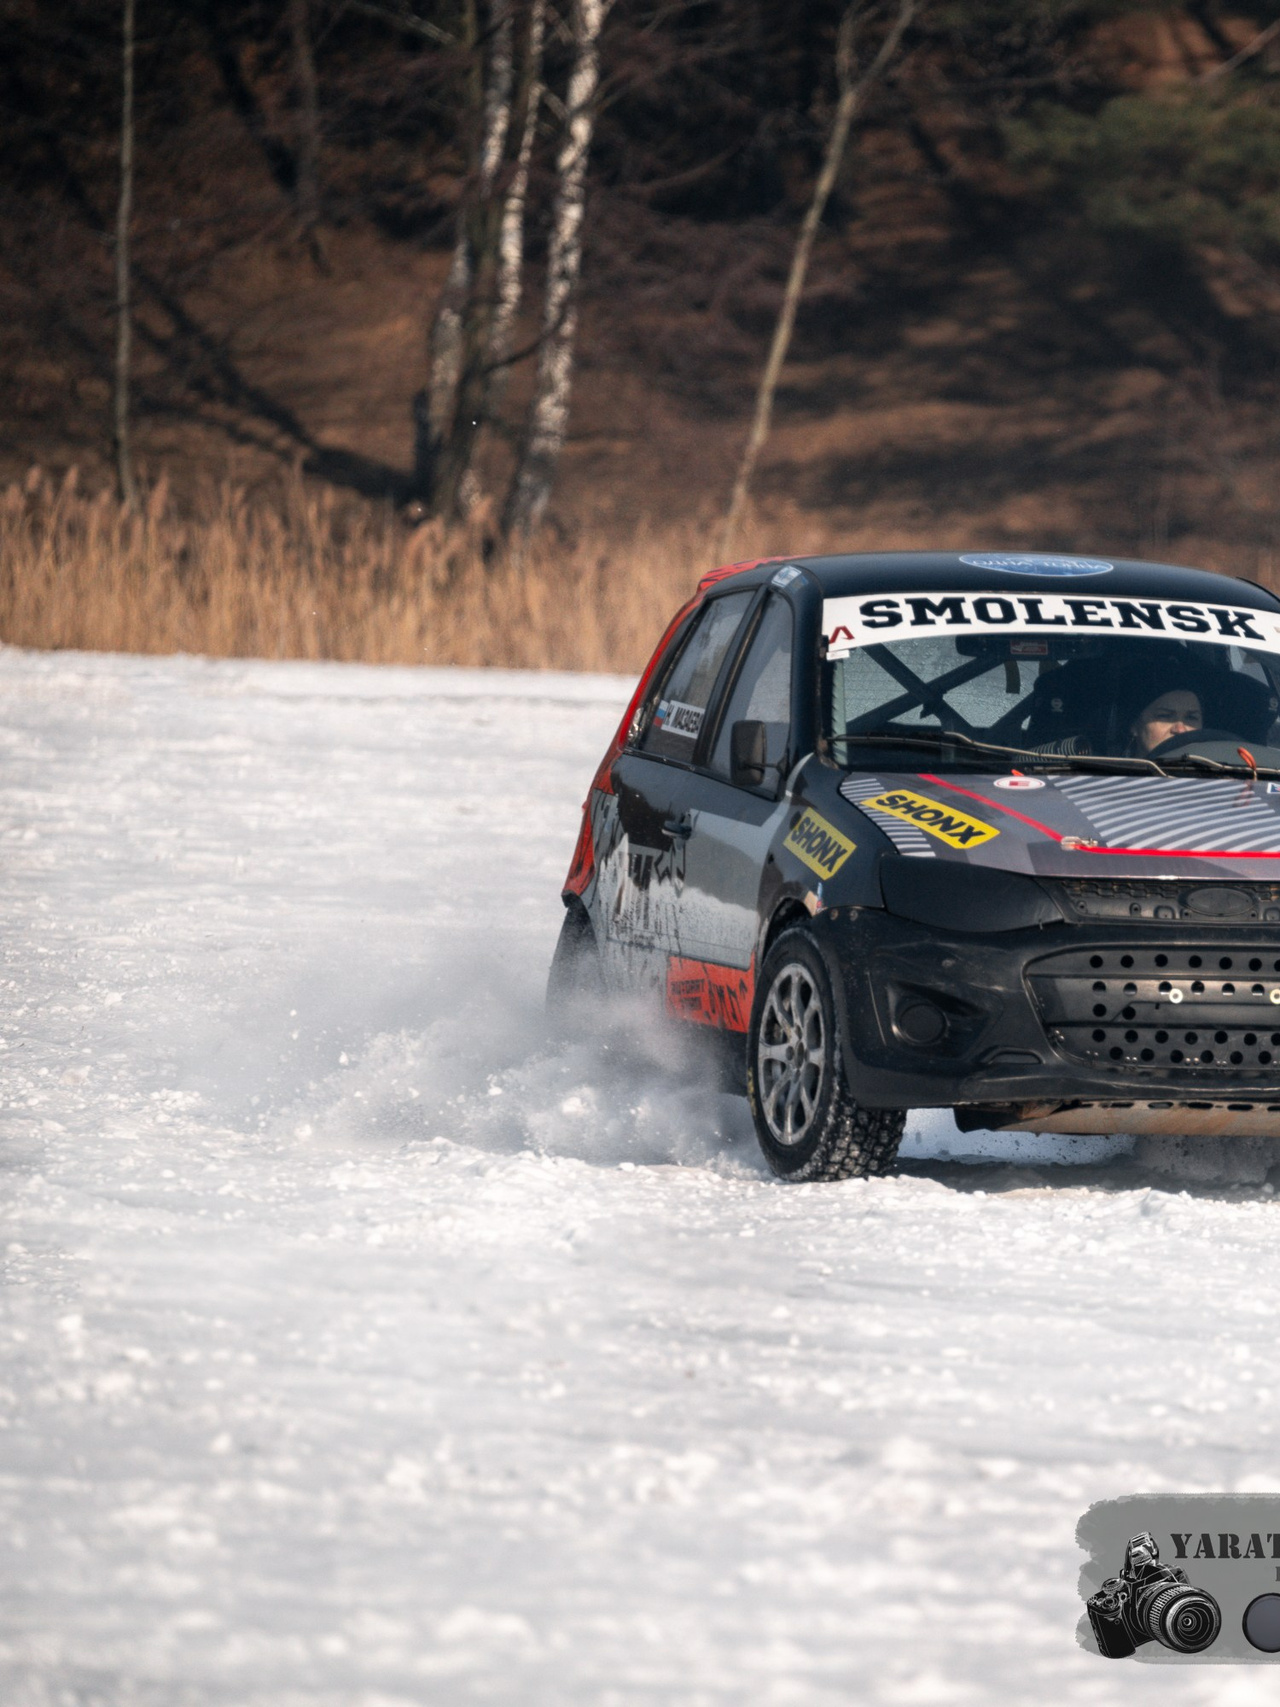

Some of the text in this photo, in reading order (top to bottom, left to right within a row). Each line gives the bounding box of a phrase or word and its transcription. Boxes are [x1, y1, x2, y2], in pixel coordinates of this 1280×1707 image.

[859, 597, 1266, 641] SMOLENSK
[791, 816, 848, 873] SHONX
[876, 794, 986, 845] SHONX
